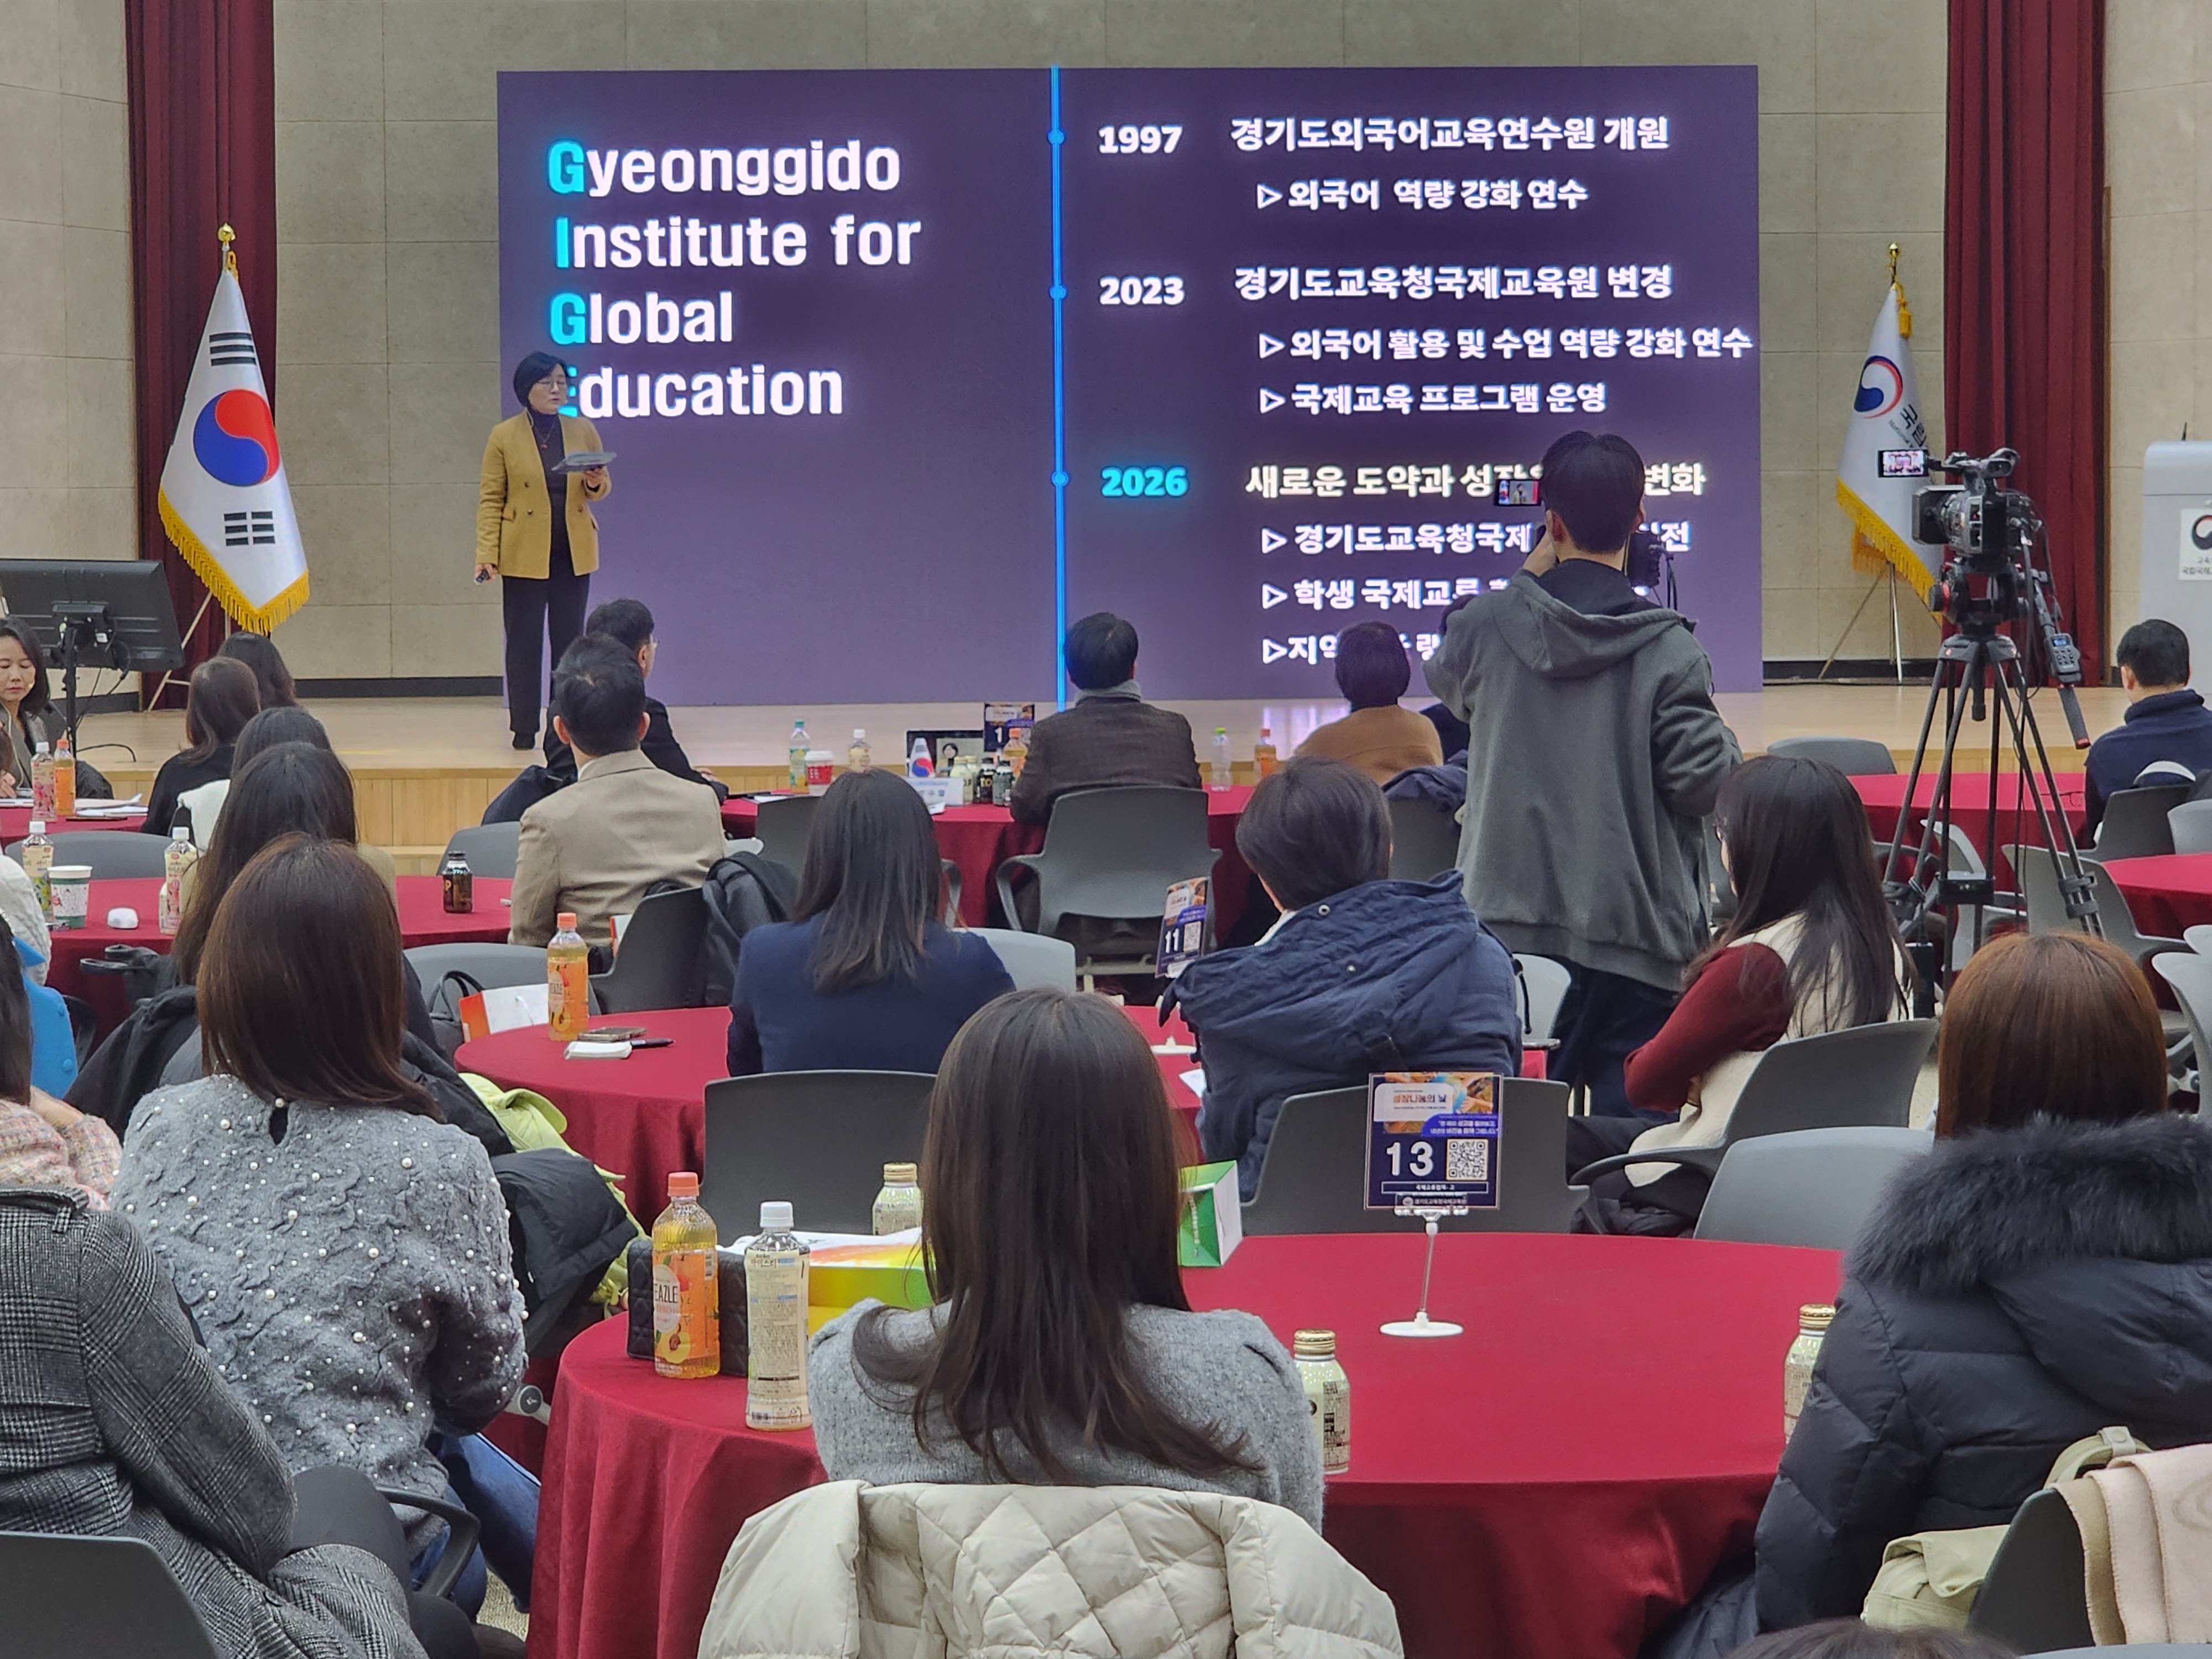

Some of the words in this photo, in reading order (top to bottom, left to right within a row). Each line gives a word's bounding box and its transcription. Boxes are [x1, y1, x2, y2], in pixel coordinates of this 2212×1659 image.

[1098, 125, 1183, 154] 1997
[1230, 116, 1596, 152] 경기도외국어교육연수원
[1603, 116, 1670, 150] 개원
[548, 139, 900, 197] Gyeonggido
[1288, 180, 1379, 211] 외국어
[1393, 180, 1455, 210] 역량
[1460, 179, 1523, 210] 강화
[1527, 179, 1588, 210] 연수
[556, 215, 807, 268] Institute
[830, 214, 922, 265] for
[1099, 276, 1185, 305] 2023
[1235, 265, 1599, 301] 경기도교육청국제교육원
[1608, 264, 1672, 299] 변경
[550, 291, 733, 345] Global
[1290, 329, 1381, 361] 외국어
[1387, 329, 1451, 360] 활용
[1457, 328, 1486, 359] 및
[1491, 328, 1552, 359] 수업
[1559, 328, 1621, 359] 역량
[1625, 327, 1688, 359] 강화
[1692, 327, 1754, 359] 연수
[1291, 384, 1414, 415] 국제교육
[1419, 384, 1540, 413] 프로그램
[1546, 382, 1606, 413] 운영
[1102, 467, 1187, 497] 2026
[1245, 465, 1347, 499] 새로운
[1353, 464, 1455, 498] 도약과
[1293, 579, 1355, 611] 학생
[1165, 927, 1180, 954] 11
[1386, 1141, 1434, 1177] 13
